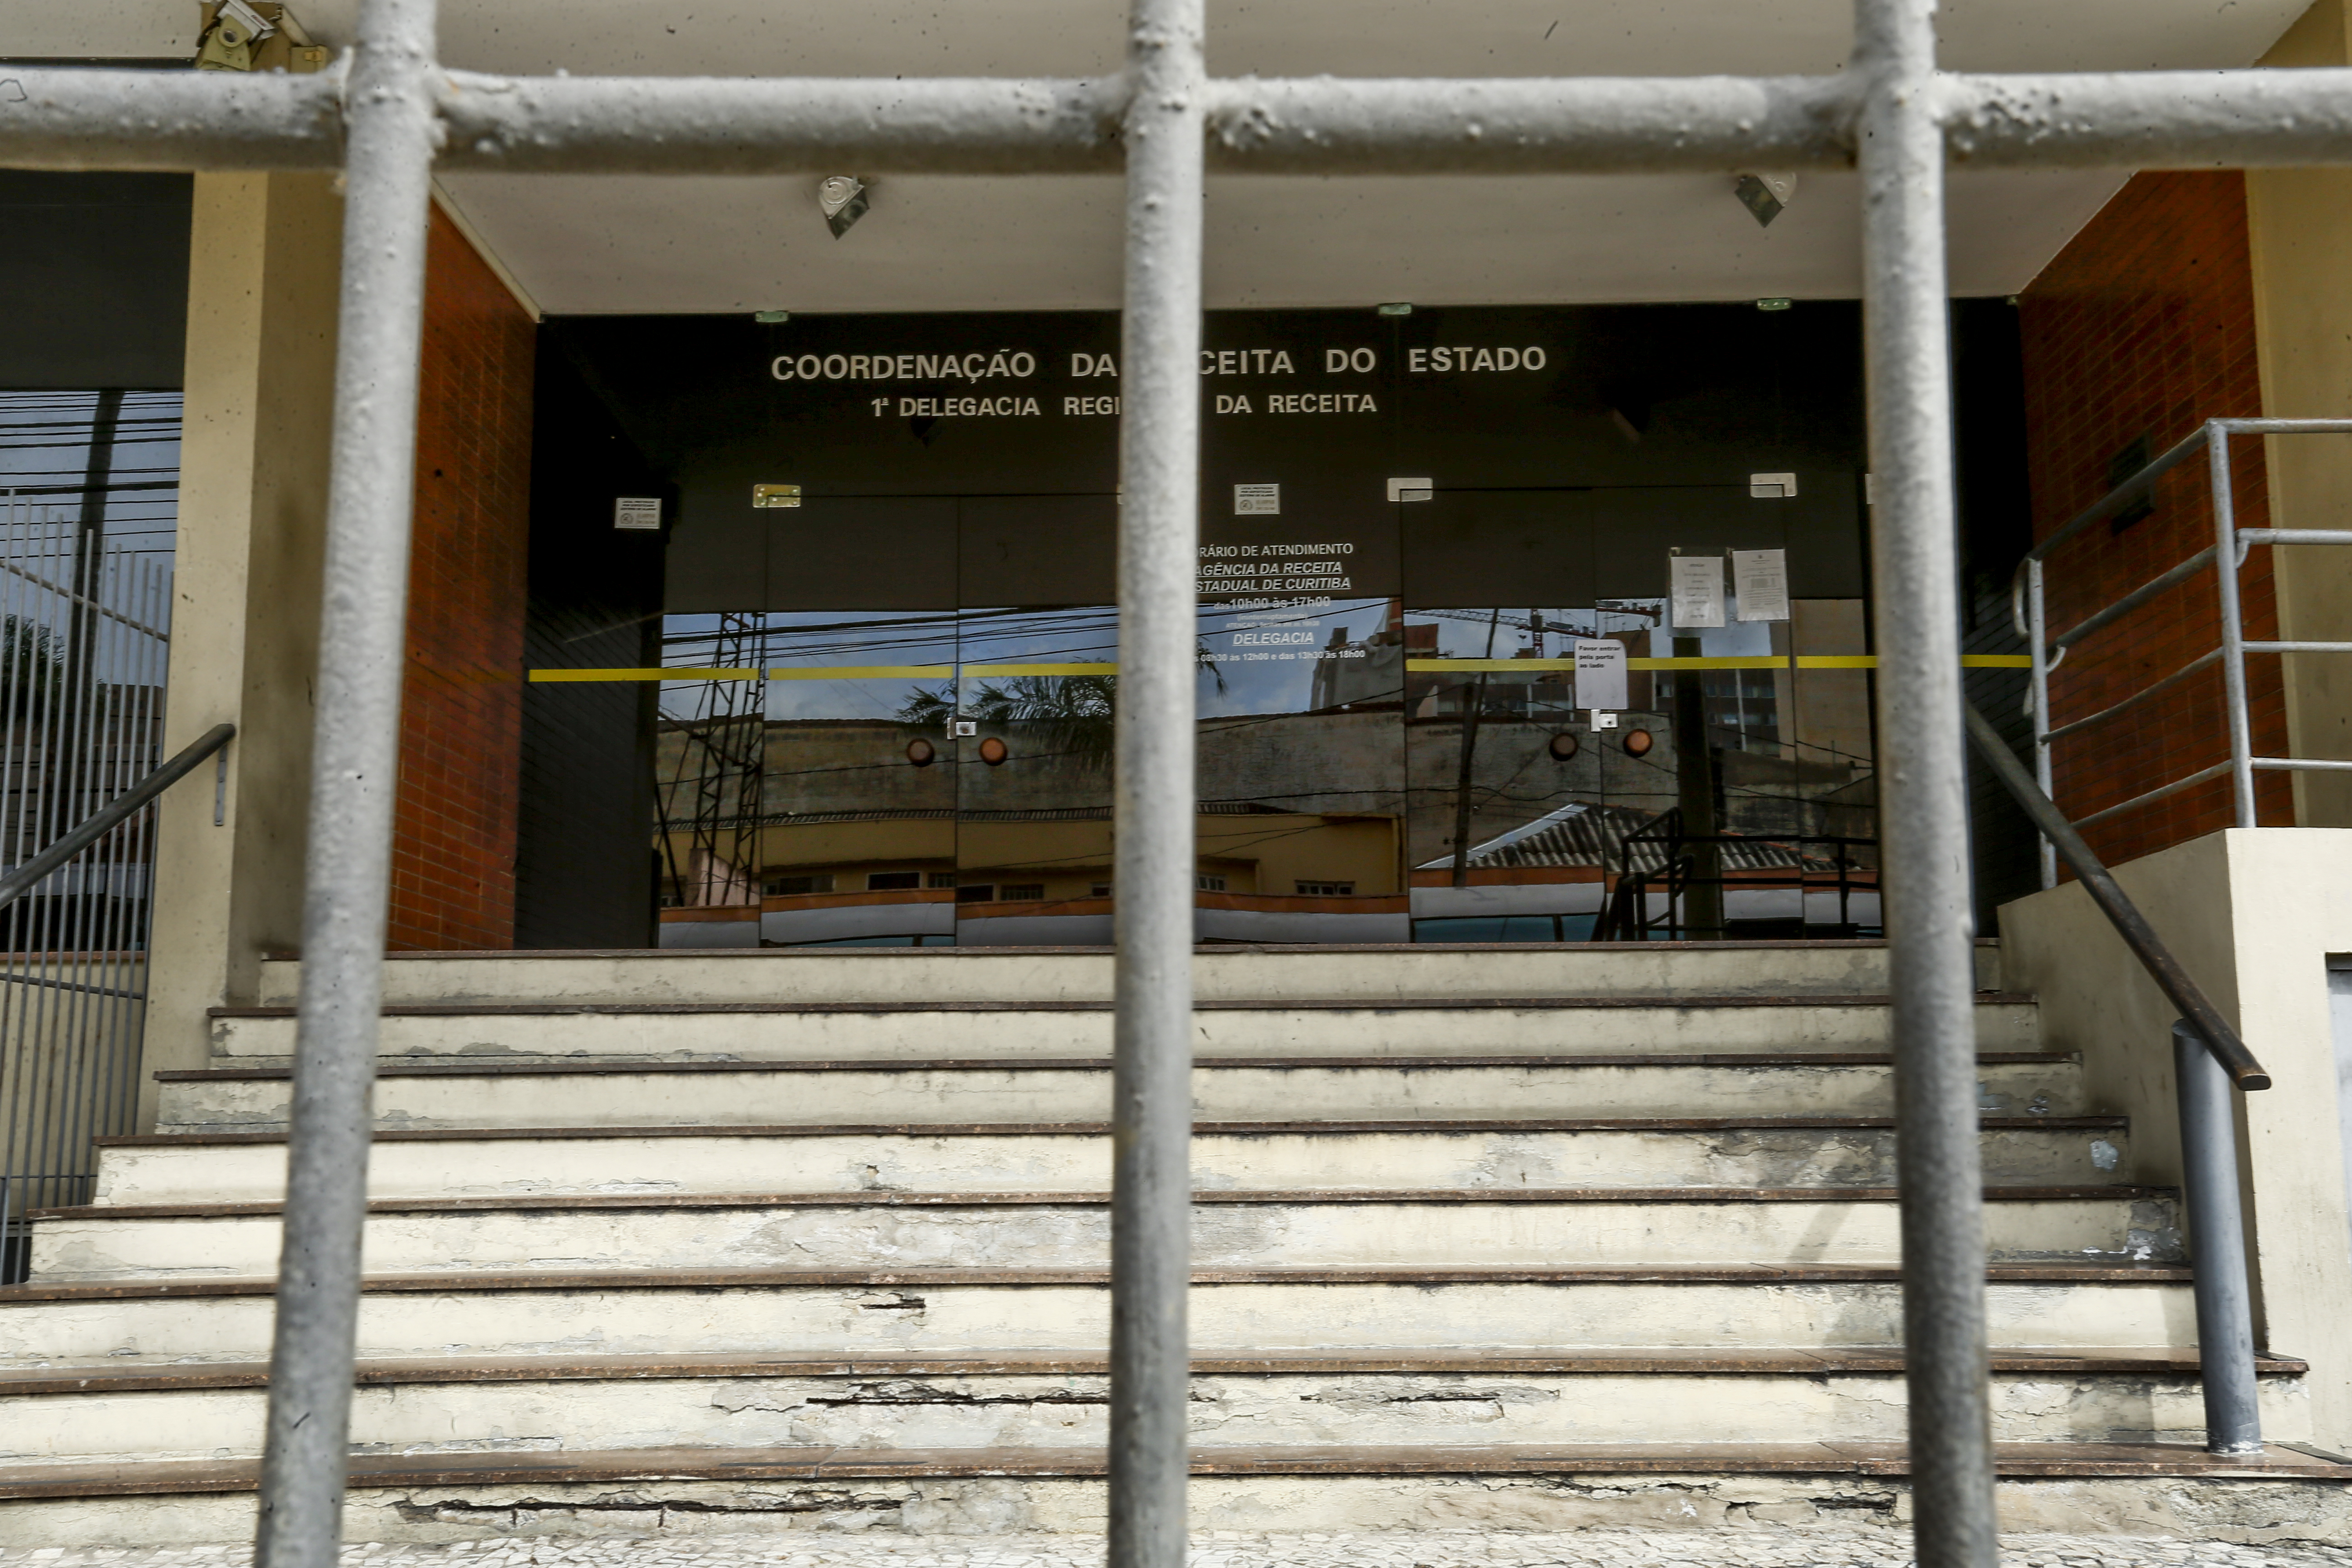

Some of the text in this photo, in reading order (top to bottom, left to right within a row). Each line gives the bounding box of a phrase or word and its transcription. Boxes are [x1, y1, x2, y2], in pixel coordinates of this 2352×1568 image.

[772, 347, 1546, 384] COORDENAÇÃO DA CEITA DO ESTADO
[899, 397, 1041, 416] DELEGACIA
[1064, 397, 1120, 415] REGI
[1216, 396, 1252, 414] DA
[1269, 393, 1377, 413] RECEITA
[1193, 544, 1353, 557] RÁRIO DE ATENDIMENTO
[1259, 563, 1279, 574] DA
[1283, 561, 1343, 573] RECEITA
[1195, 577, 1352, 592] STADUAL DE CURITIBA
[1272, 597, 1288, 608] às
[1292, 596, 1330, 607] 17h00
[1233, 632, 1314, 645] DELEGACIA
[1242, 652, 1269, 661] 12h00
[1338, 650, 1366, 658] 18h00
